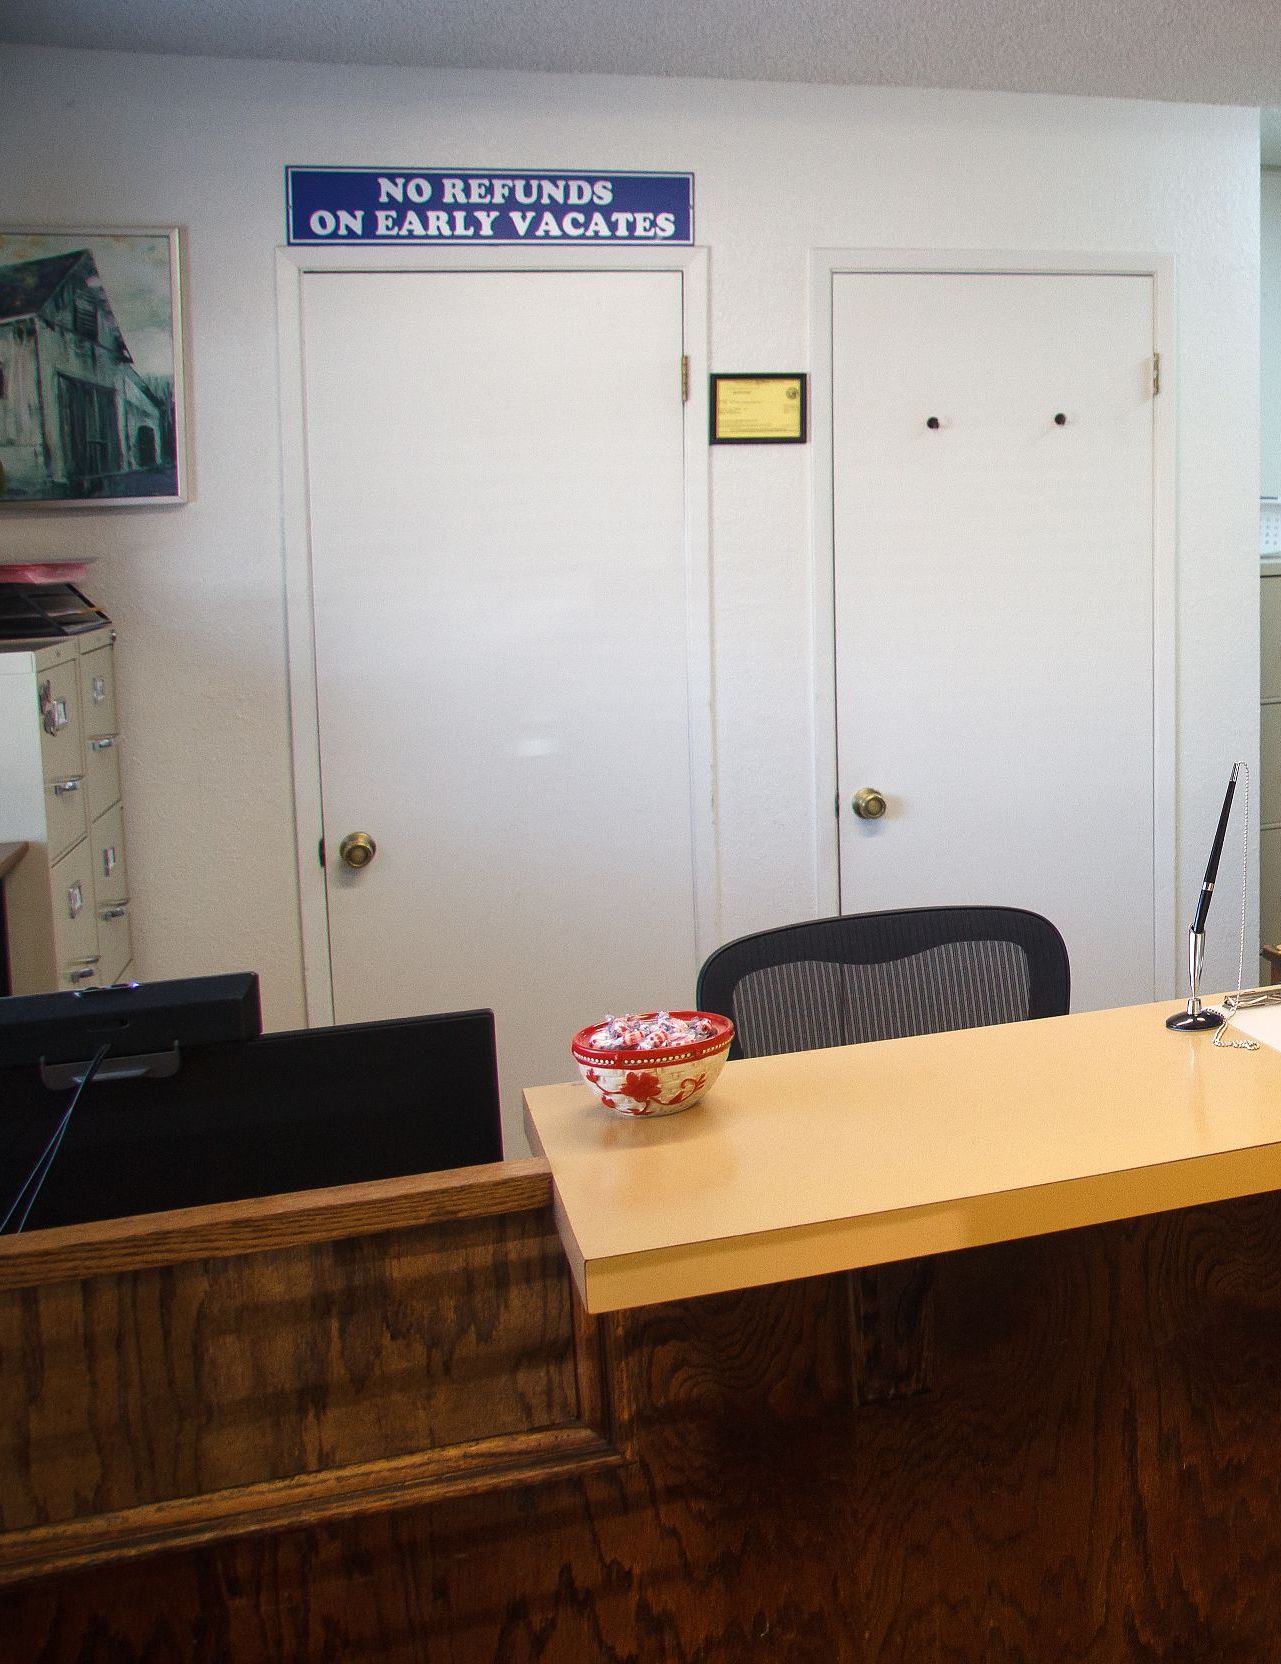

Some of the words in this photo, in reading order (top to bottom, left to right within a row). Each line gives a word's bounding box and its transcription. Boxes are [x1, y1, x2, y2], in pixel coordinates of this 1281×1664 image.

[377, 176, 433, 204] NO
[441, 178, 614, 206] REFUNDS
[309, 209, 365, 237] ON
[374, 209, 500, 237] EARLY
[508, 211, 676, 238] VACATES
